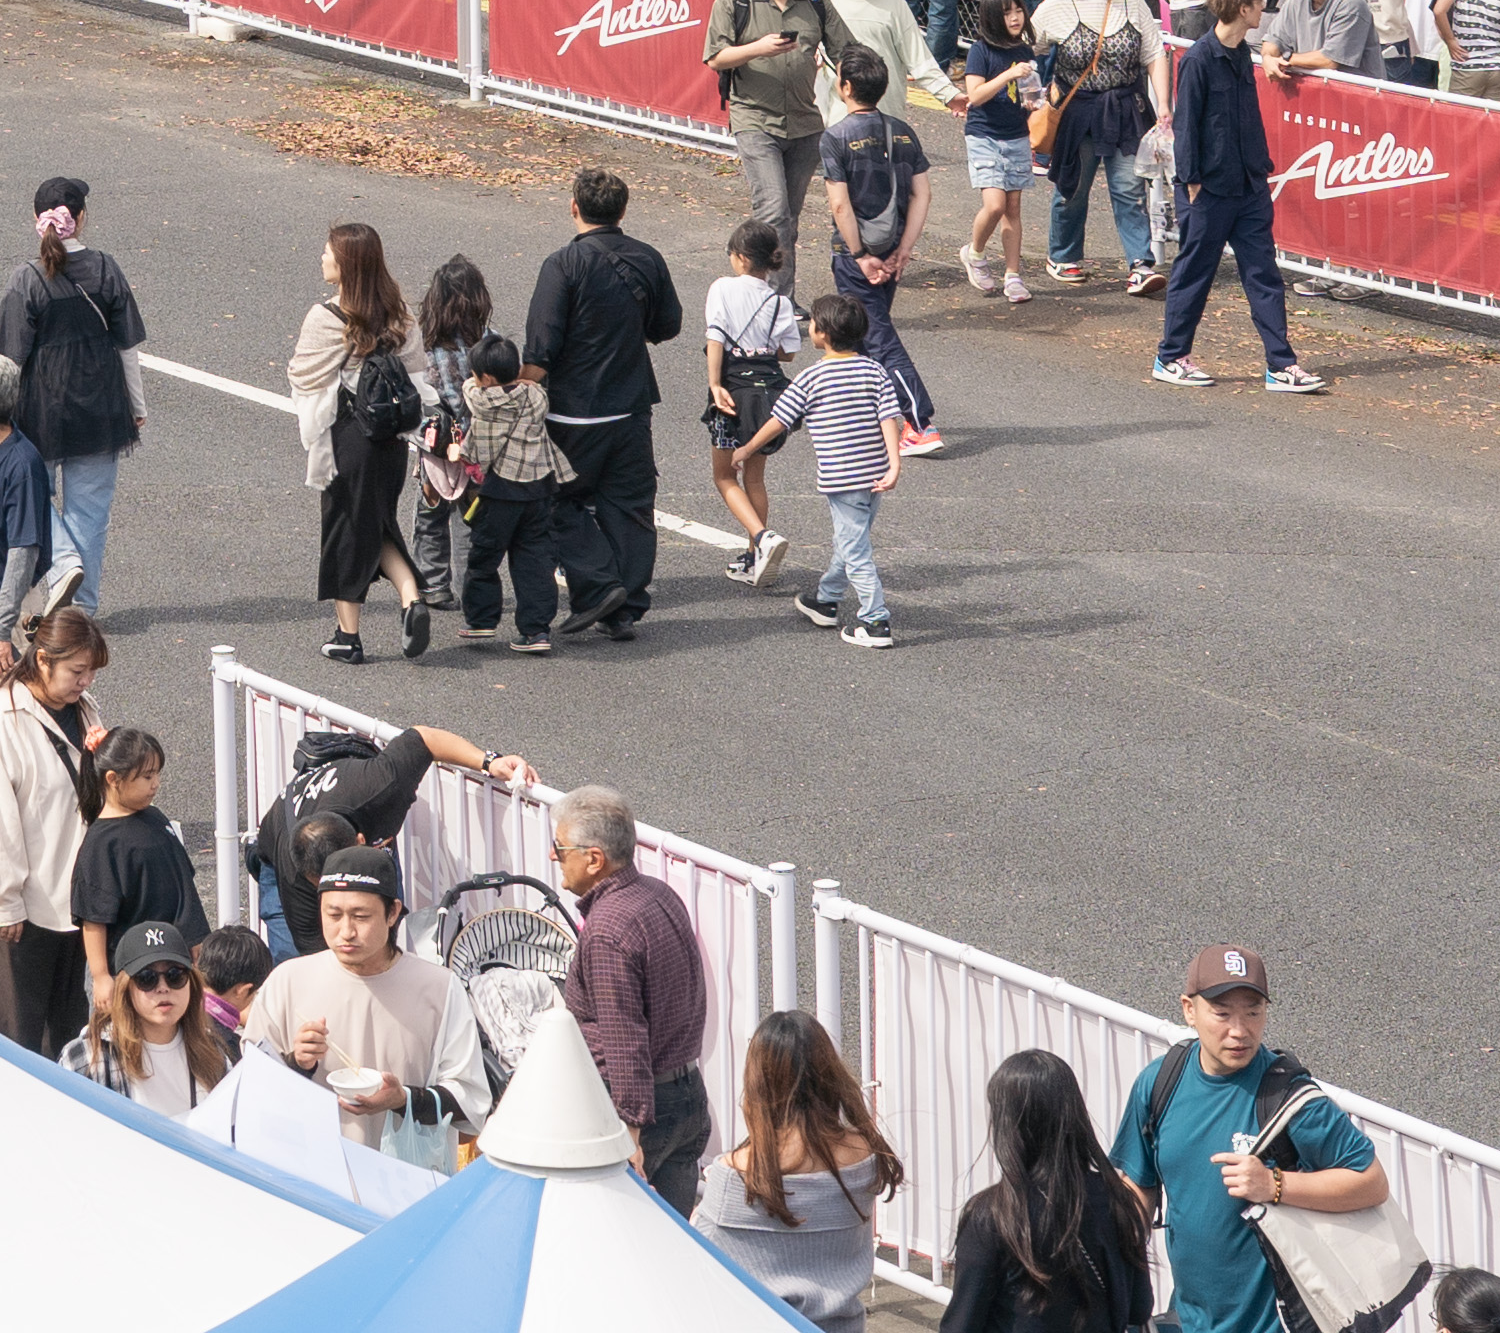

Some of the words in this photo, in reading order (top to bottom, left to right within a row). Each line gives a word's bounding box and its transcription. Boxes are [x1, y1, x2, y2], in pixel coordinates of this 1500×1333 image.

[1283, 109, 1363, 137] KASHIMA
[1267, 132, 1451, 203] Antlers
[144, 928, 166, 946] NY
